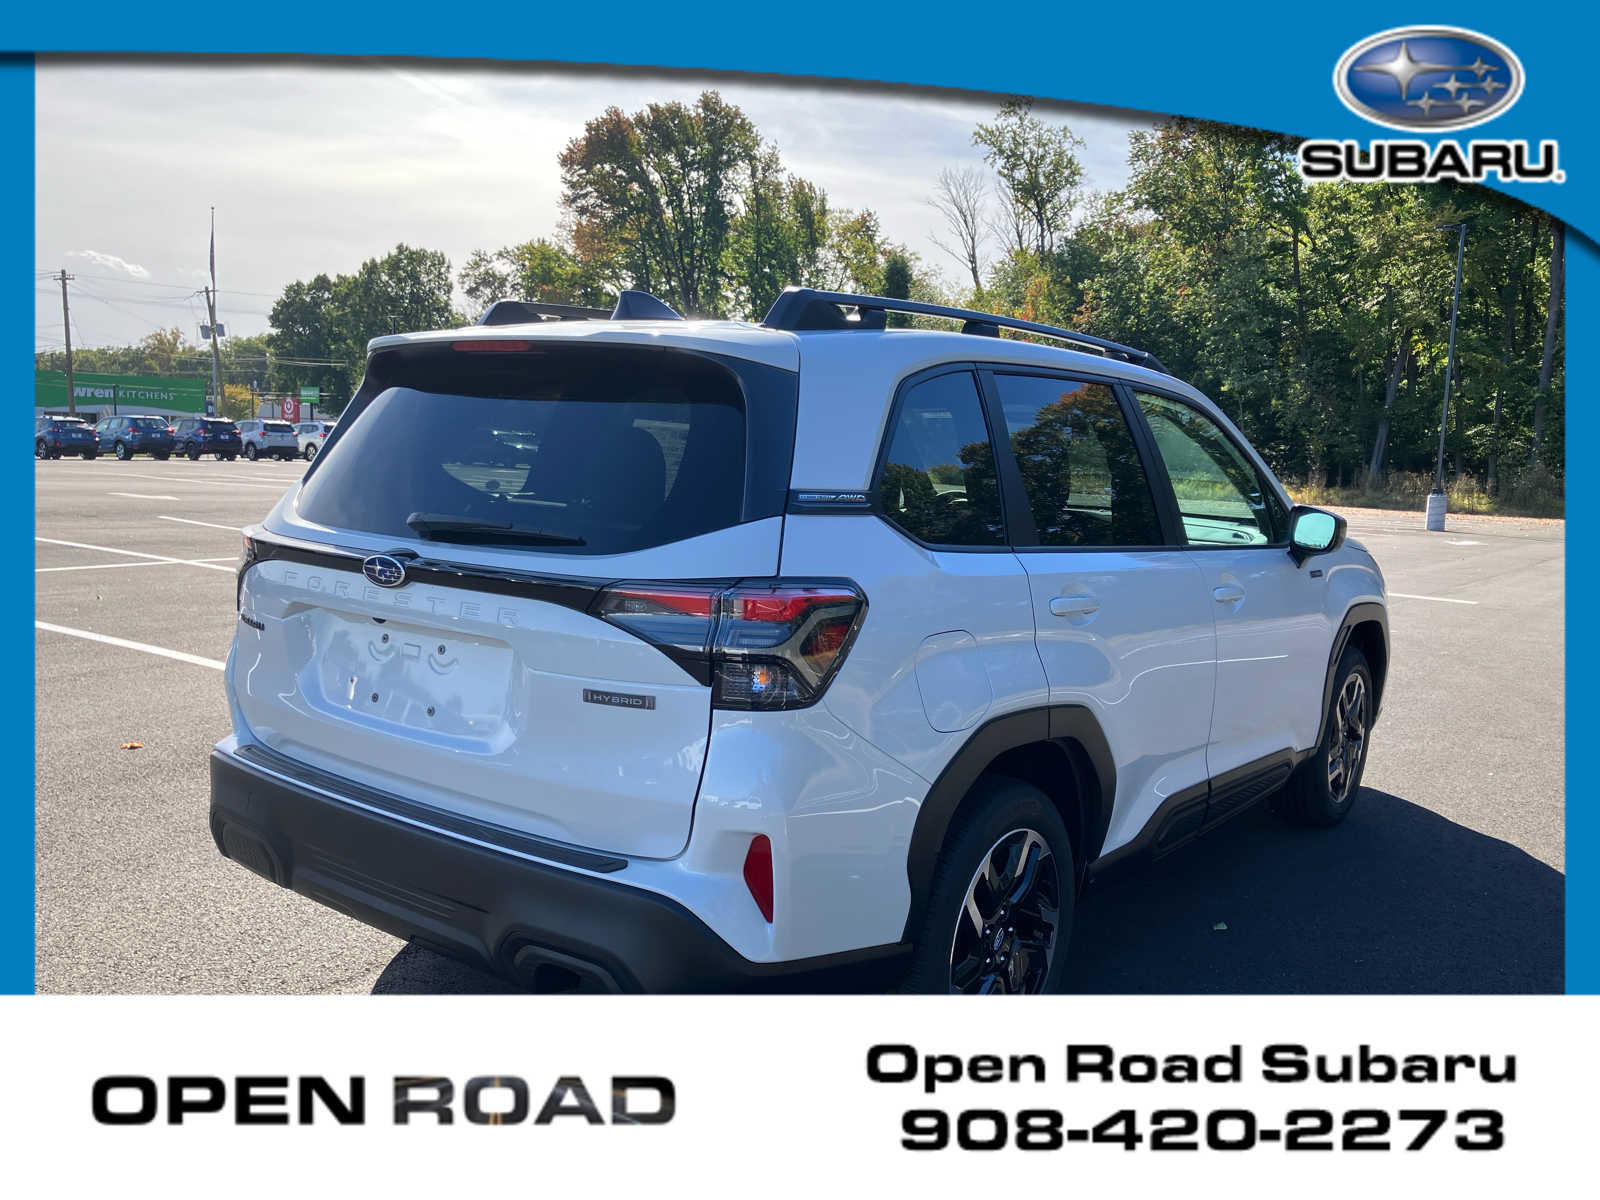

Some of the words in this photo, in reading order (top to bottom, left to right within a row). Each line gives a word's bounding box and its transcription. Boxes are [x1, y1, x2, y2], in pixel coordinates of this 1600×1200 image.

[73, 387, 113, 398] wren
[118, 390, 175, 400] KITCHENS
[283, 568, 520, 627] FORESTER
[593, 694, 642, 706] HYBRID
